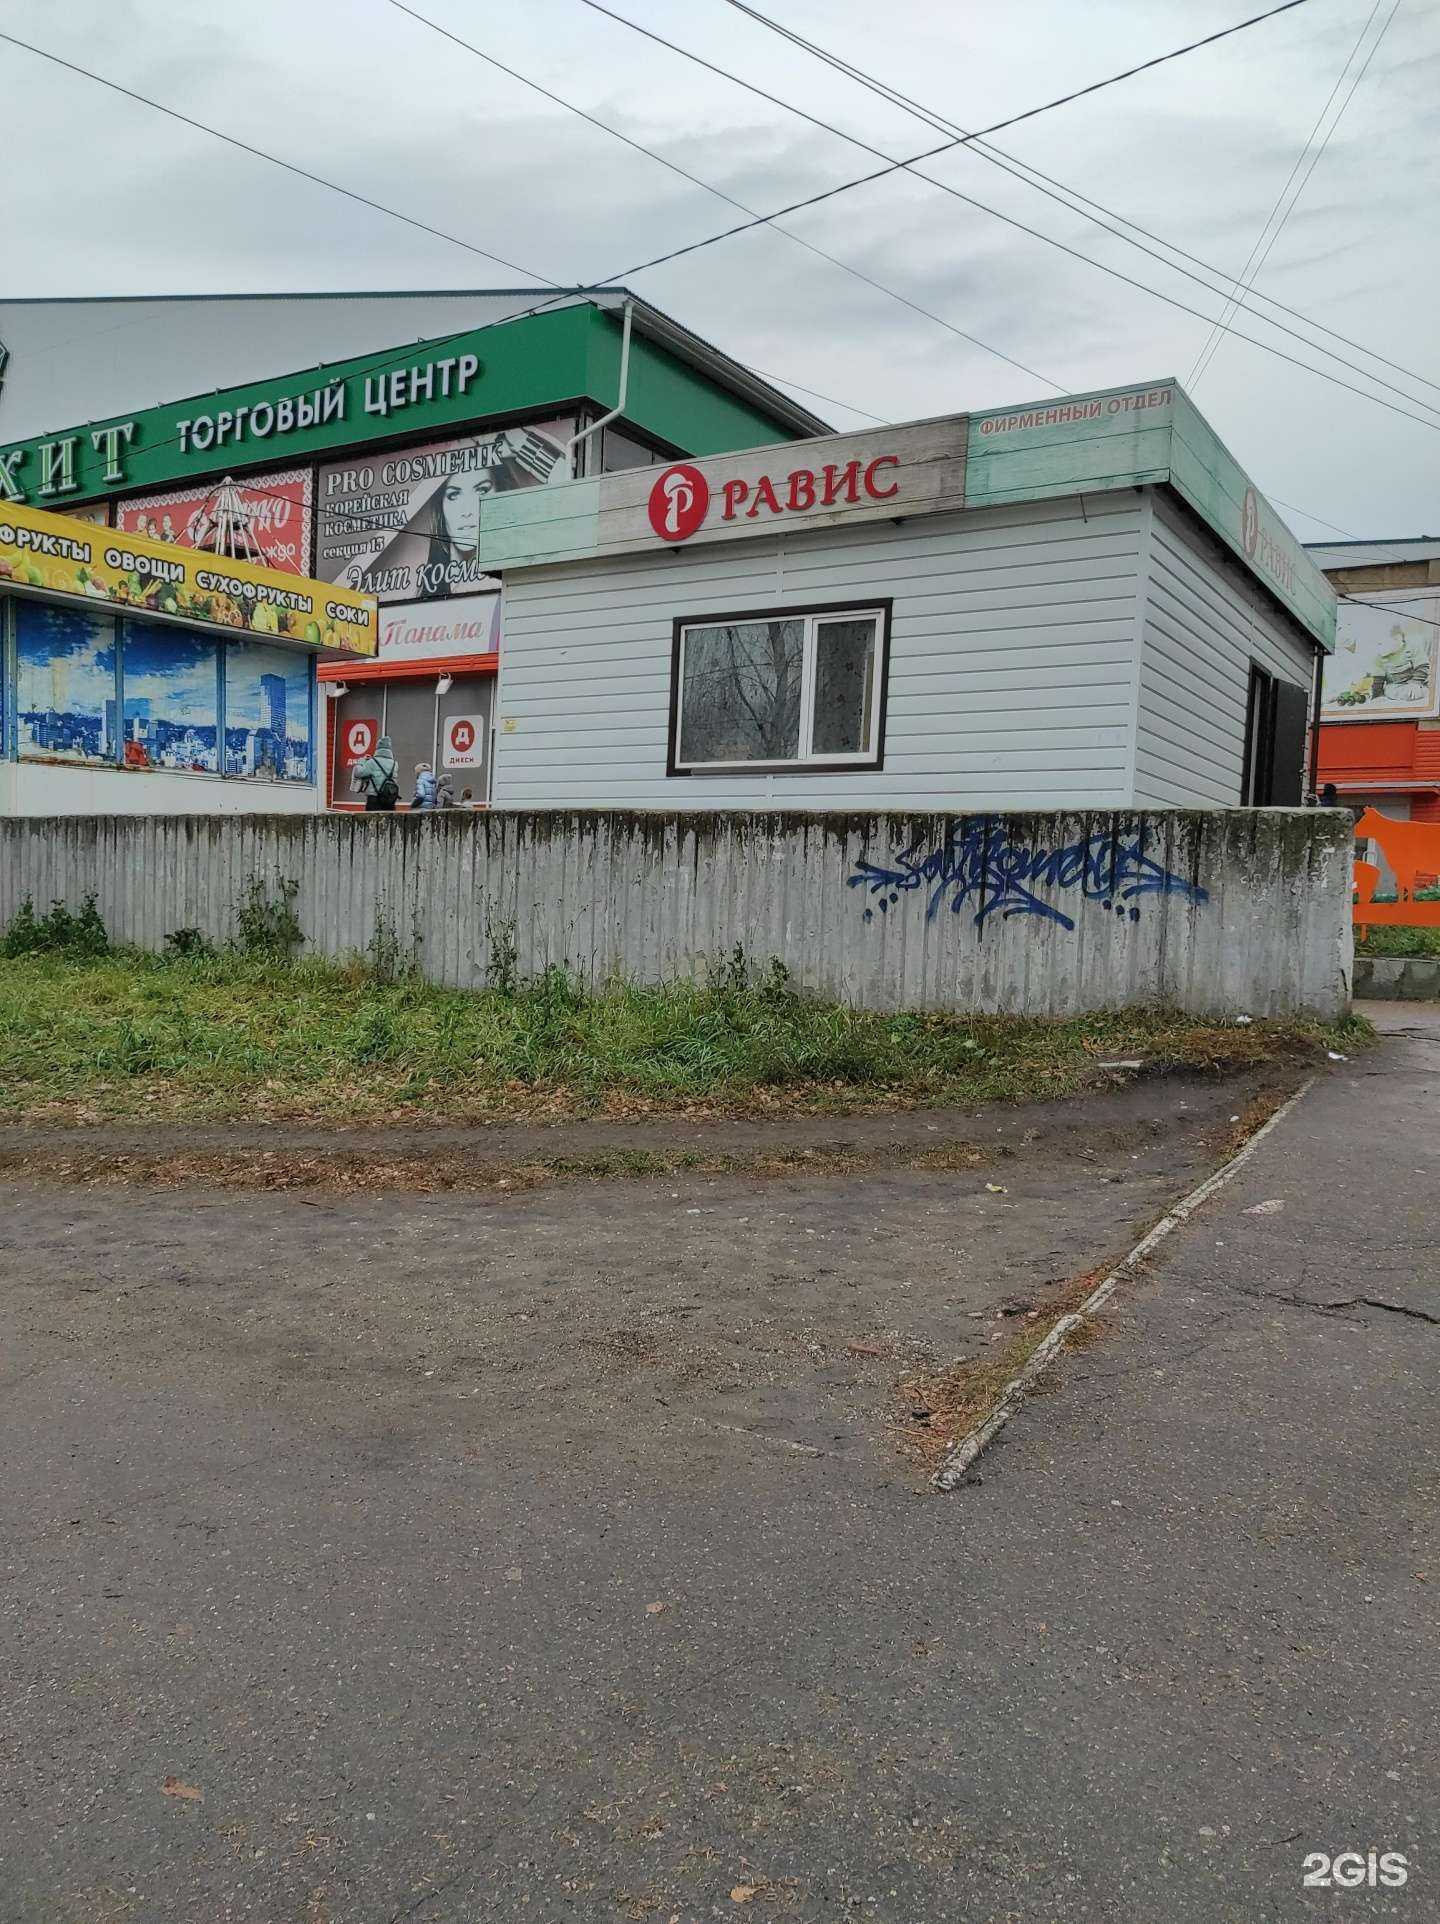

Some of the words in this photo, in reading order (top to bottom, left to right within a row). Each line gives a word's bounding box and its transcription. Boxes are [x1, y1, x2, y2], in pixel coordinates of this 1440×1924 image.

[176, 377, 345, 453] ТОРГОВЫЙ
[364, 354, 479, 417] ЦЕНТР
[979, 399, 1102, 437] ФИРМЕННЫЙ
[1106, 389, 1173, 415] ОТДЕЛ
[326, 466, 374, 496] PRO
[381, 443, 503, 487] COSMETIK
[721, 455, 900, 521] РАВИС
[323, 510, 410, 537] КОСМЕТИКА
[325, 489, 410, 518] КОРЕЙСКАЯ
[323, 541, 367, 560] секция
[0, 524, 91, 564] ФРУКТЫ
[104, 547, 185, 584] ОВОЩИ
[196, 571, 312, 614] СУХОФРУКТЫ
[325, 600, 369, 627] СОКИ
[347, 564, 411, 594] Элит
[416, 559, 485, 593] косм
[379, 619, 485, 647] Панама
